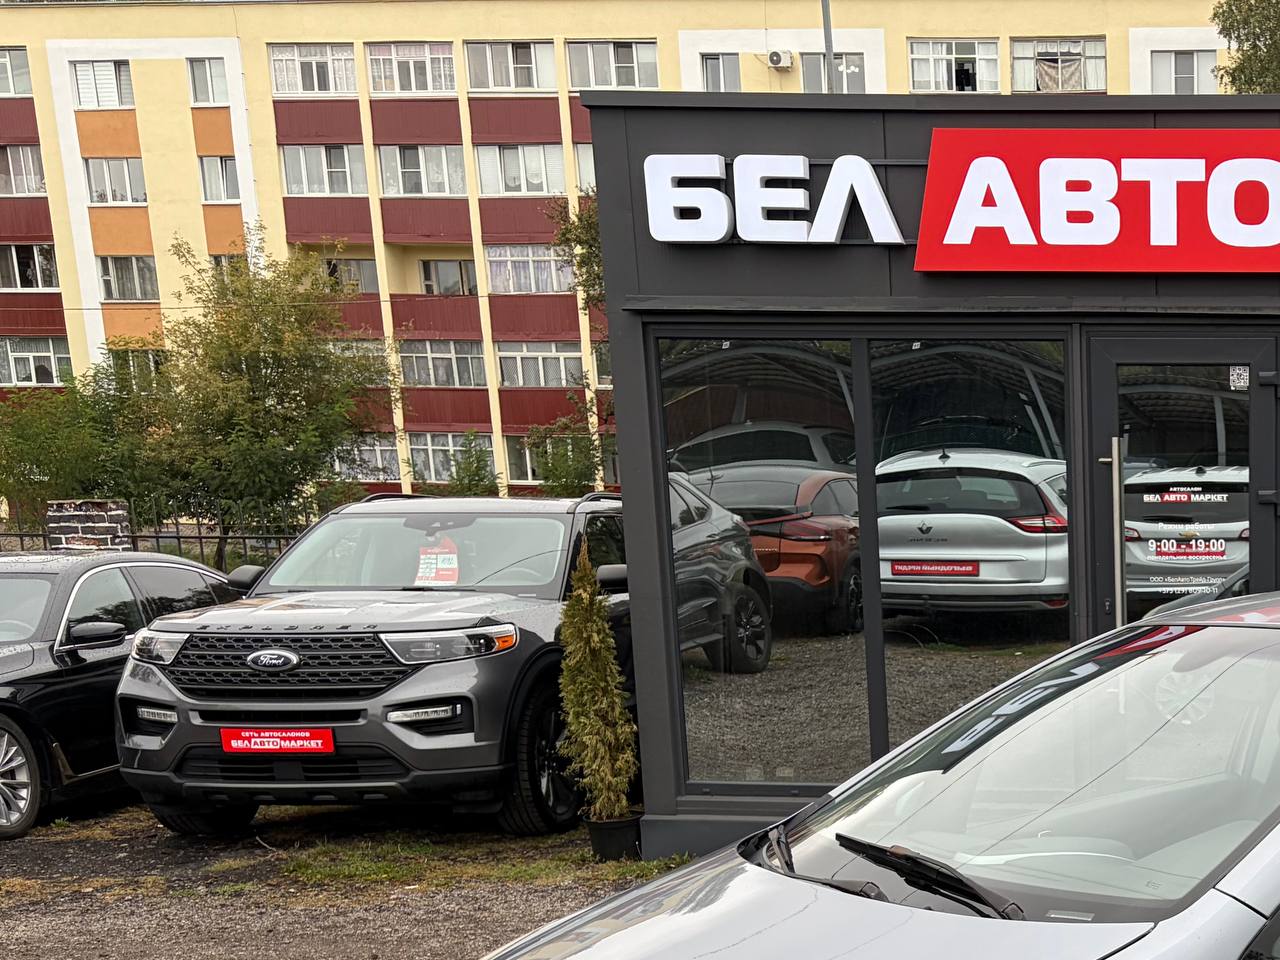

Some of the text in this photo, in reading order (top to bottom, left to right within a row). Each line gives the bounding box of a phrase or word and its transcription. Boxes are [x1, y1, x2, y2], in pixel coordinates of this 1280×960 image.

[643, 154, 906, 244] БЕЛ
[1143, 494, 1161, 502] БЕЛ
[1191, 494, 1228, 502] МАРКЕТ
[1148, 539, 1177, 551] 9:00
[1190, 539, 1225, 551] 19:00
[258, 654, 285, 666] Ford
[231, 740, 323, 748] БЕЛ АВТО МАРКЕТ
